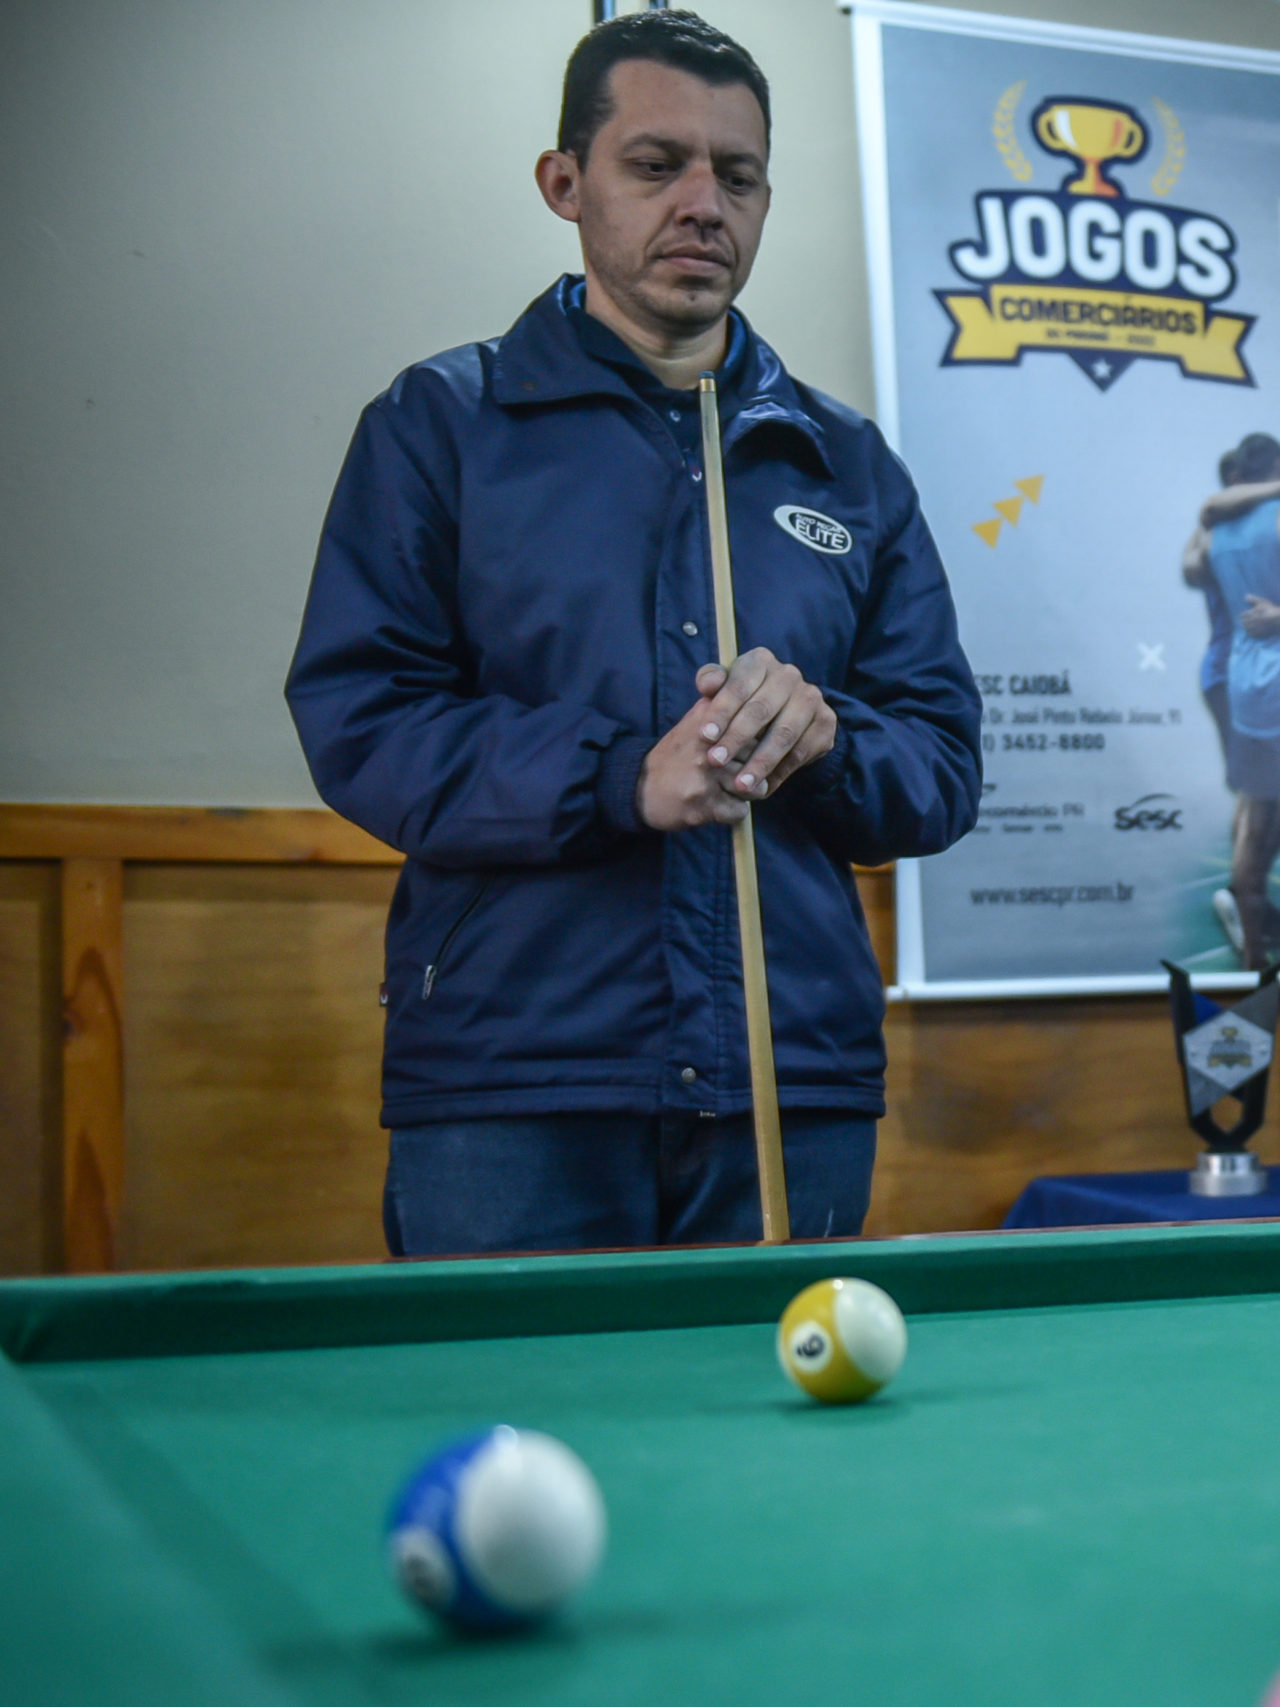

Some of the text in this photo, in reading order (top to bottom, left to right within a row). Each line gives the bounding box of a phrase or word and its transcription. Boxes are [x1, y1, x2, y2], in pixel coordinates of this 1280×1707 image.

[952, 196, 1233, 297] JOGOS
[1000, 296, 1198, 335] COMERCIÁRIOS
[796, 518, 846, 549] ELITE
[1009, 669, 1071, 695] CAIOBÁ
